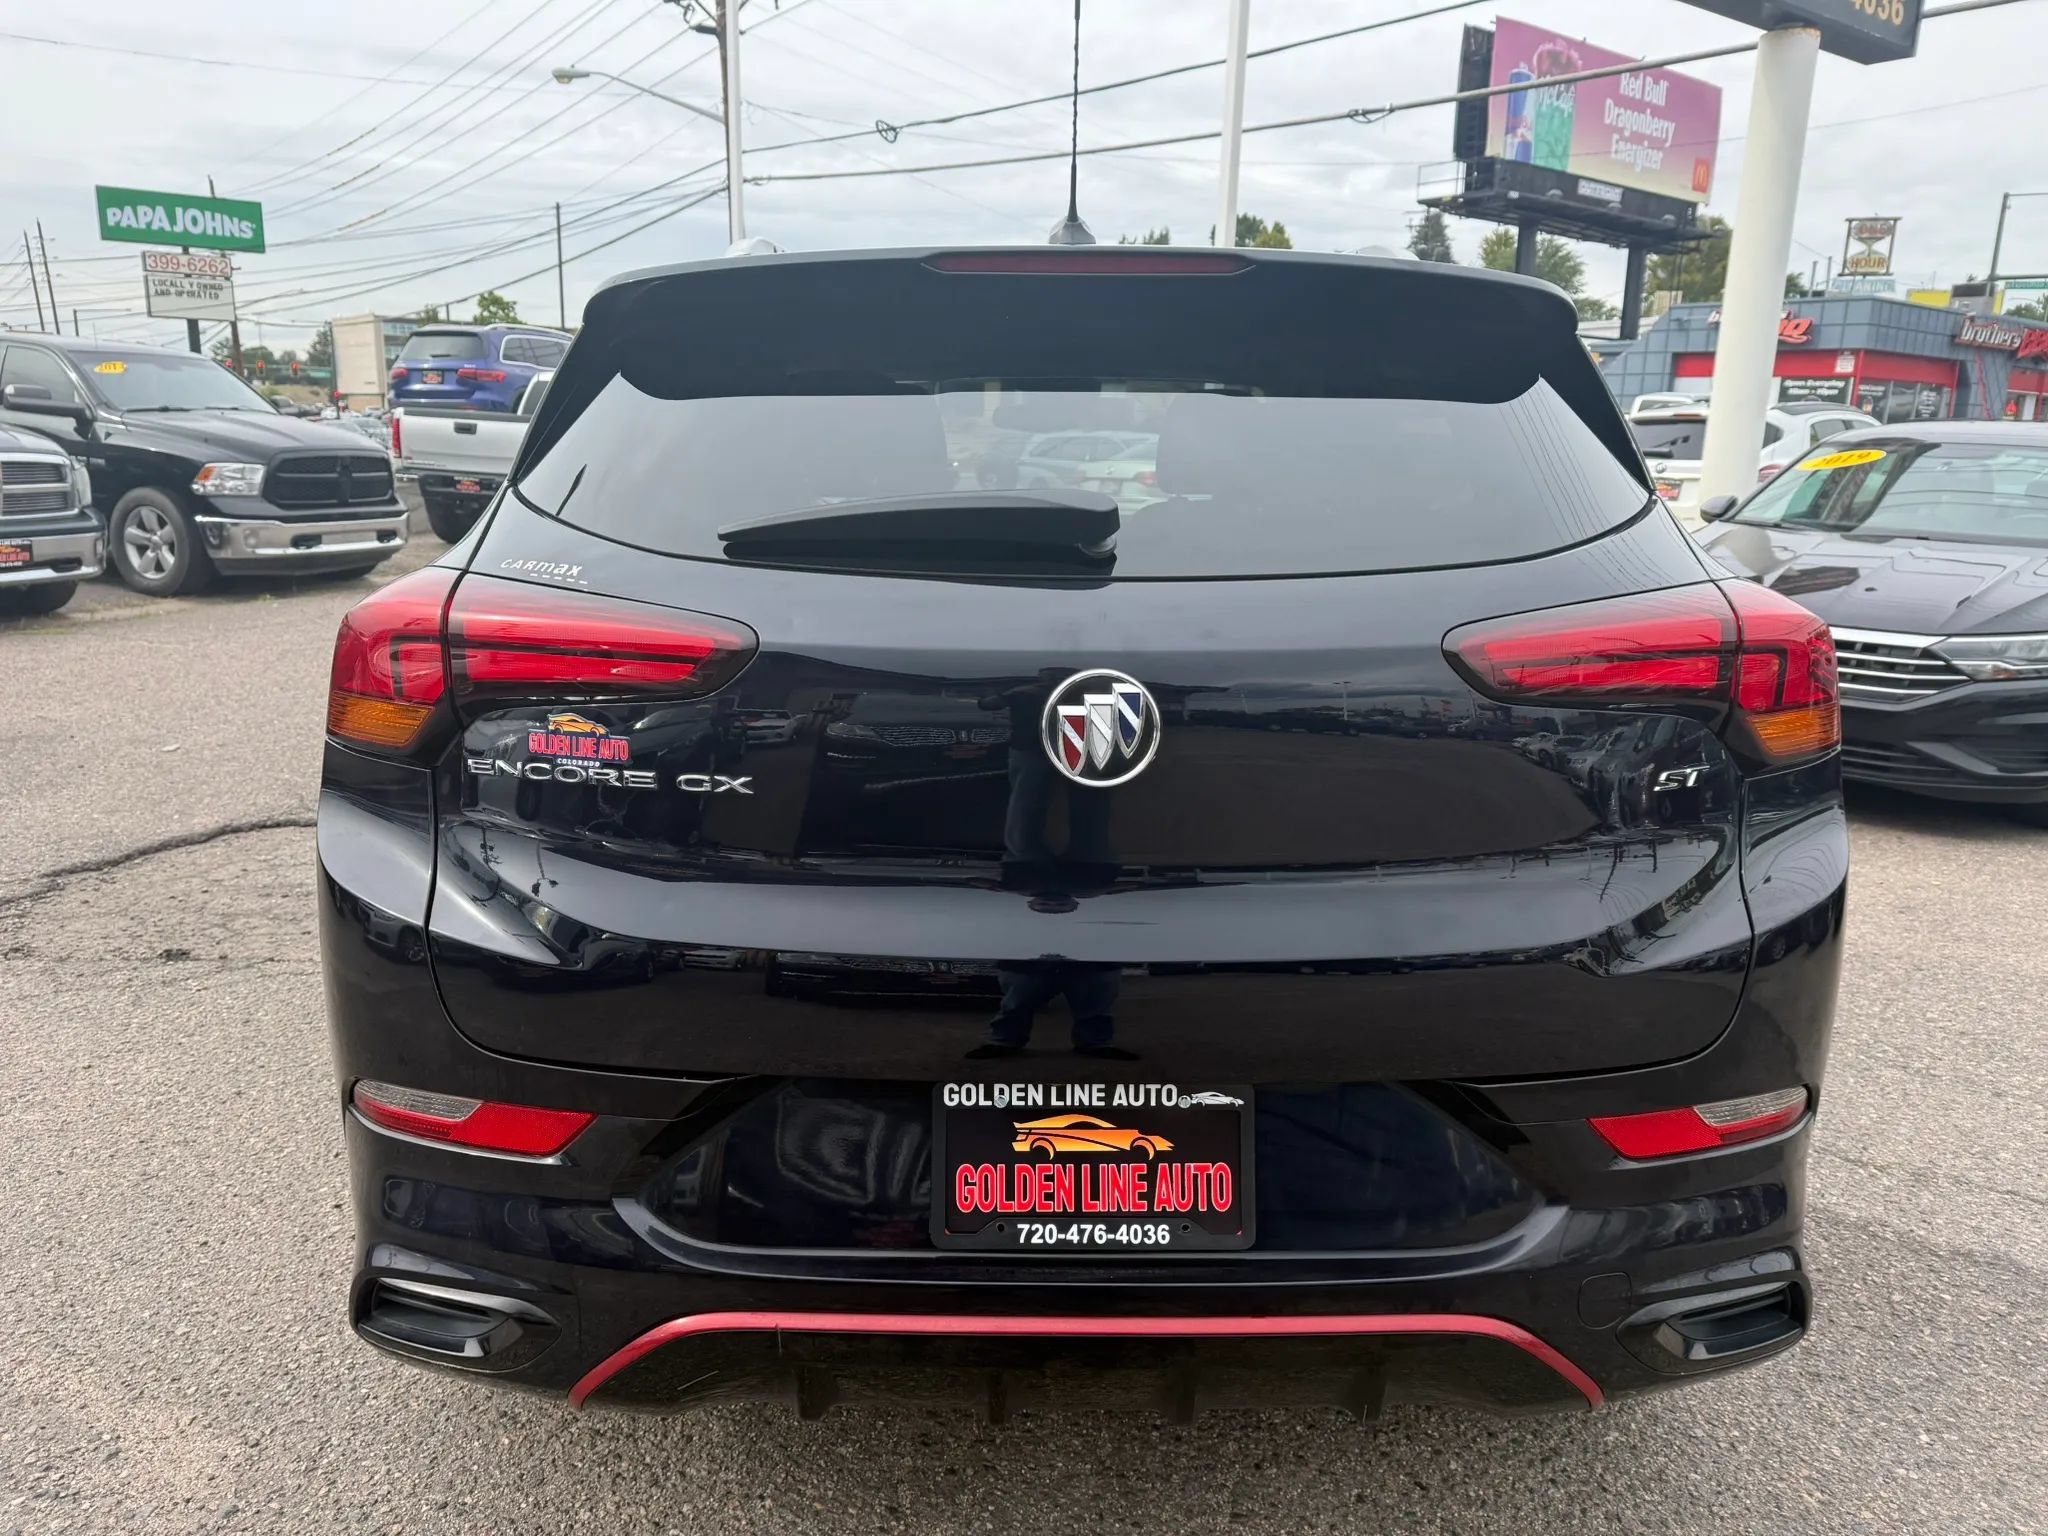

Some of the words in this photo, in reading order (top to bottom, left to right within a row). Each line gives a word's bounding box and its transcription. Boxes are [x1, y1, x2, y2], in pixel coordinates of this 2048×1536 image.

[1619, 72, 1643, 98] Red
[1645, 75, 1668, 106] Bull
[1604, 98, 1676, 147] Dragonberry
[1611, 134, 1664, 172] Energizer
[106, 205, 171, 231] PAPA
[173, 206, 255, 239] JOHNS
[148, 254, 229, 275] 399-6262
[1850, 256, 1887, 269] HOUR
[1960, 319, 2021, 347] brothers
[528, 732, 571, 757] GOLDEN
[572, 735, 597, 759] LINE
[598, 738, 629, 761] AUTO
[467, 758, 658, 791] ENCORE
[676, 774, 754, 794] GX
[557, 757, 600, 767] COLORADO
[1653, 765, 1710, 791] ST
[943, 1082, 1043, 1107] GOLDEN
[1050, 1083, 1105, 1107] LINE
[1112, 1083, 1178, 1107] AUTO
[956, 1163, 1075, 1213] GOLDEN
[1081, 1163, 1148, 1212] LINE
[1154, 1162, 1232, 1212] AUTO
[1016, 1224, 1171, 1245] 720-476-4036
